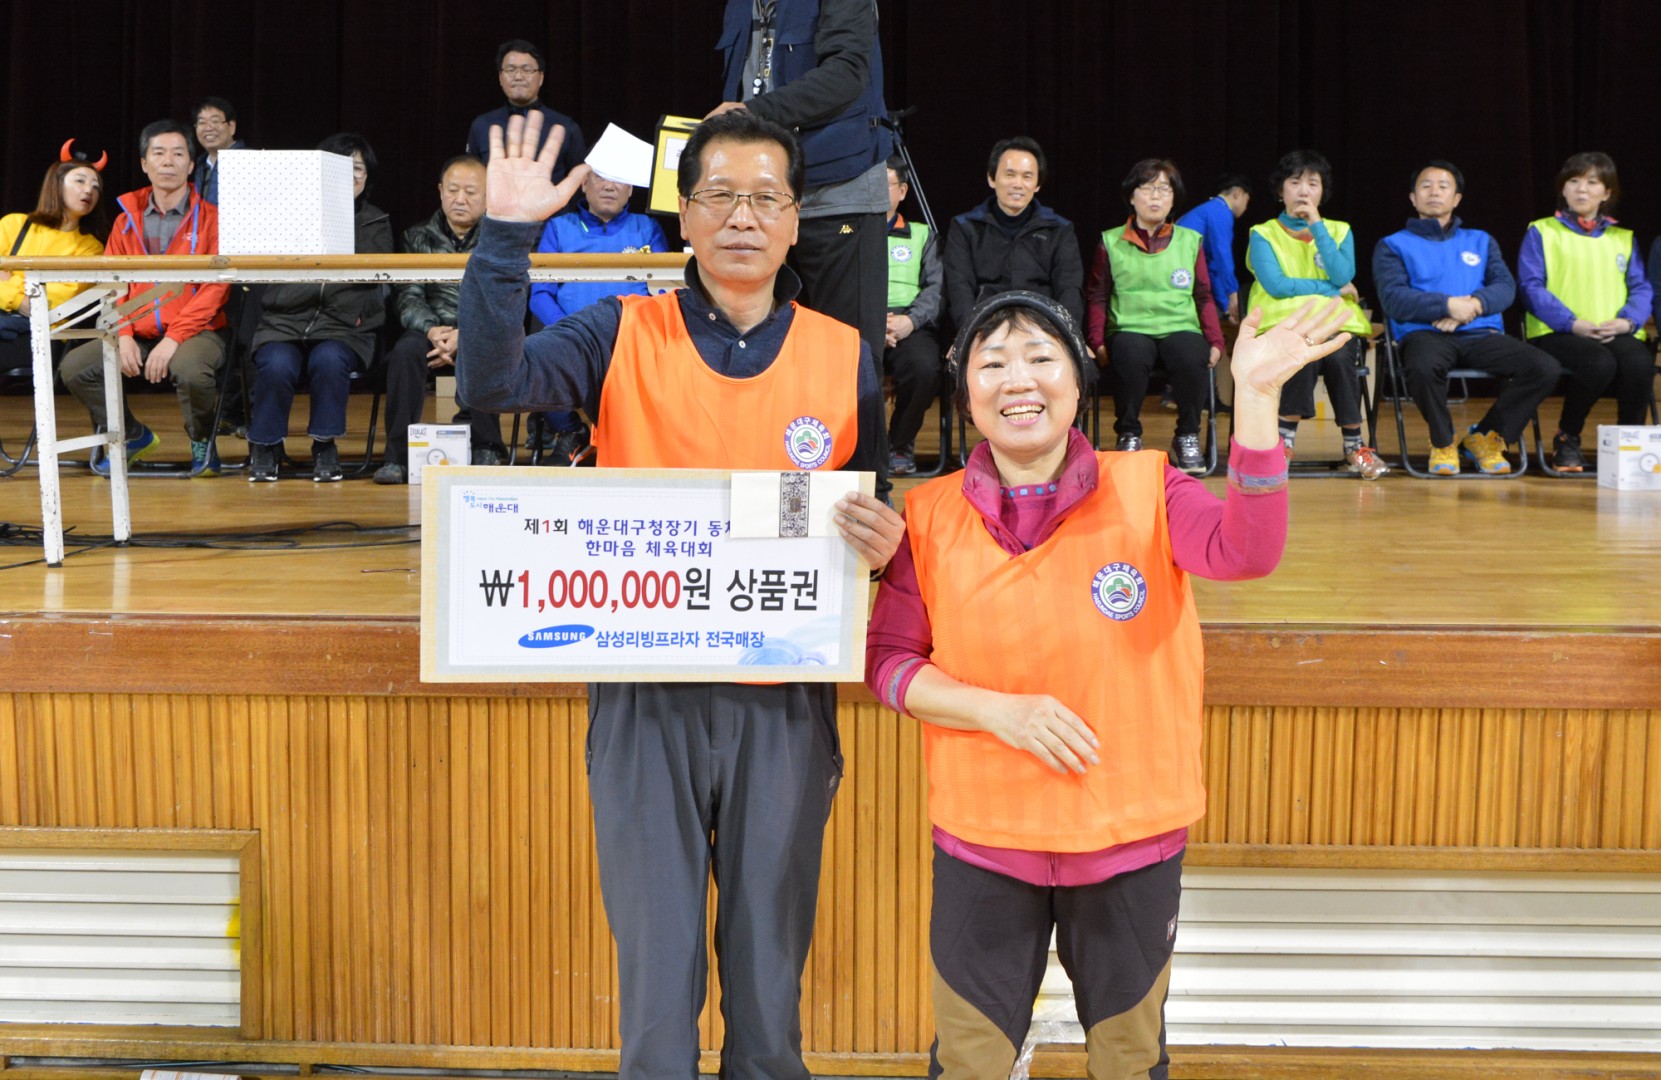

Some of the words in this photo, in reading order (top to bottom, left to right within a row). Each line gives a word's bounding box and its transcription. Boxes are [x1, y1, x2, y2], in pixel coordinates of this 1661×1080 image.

[483, 503, 519, 514] 해운대
[524, 518, 569, 535] 제1회
[578, 518, 698, 537] 해운대구청장기
[585, 539, 637, 557] 한마음
[645, 540, 713, 558] 체육대회
[479, 567, 711, 614] ₩1,000,000원
[726, 568, 819, 612] 상품권
[1114, 610, 1135, 620] SPORTS
[1132, 589, 1146, 613] COUNCIL
[527, 631, 587, 642] SAMSUNG
[595, 630, 700, 649] 삼성리빙프라자
[705, 630, 766, 649] 전국매장
